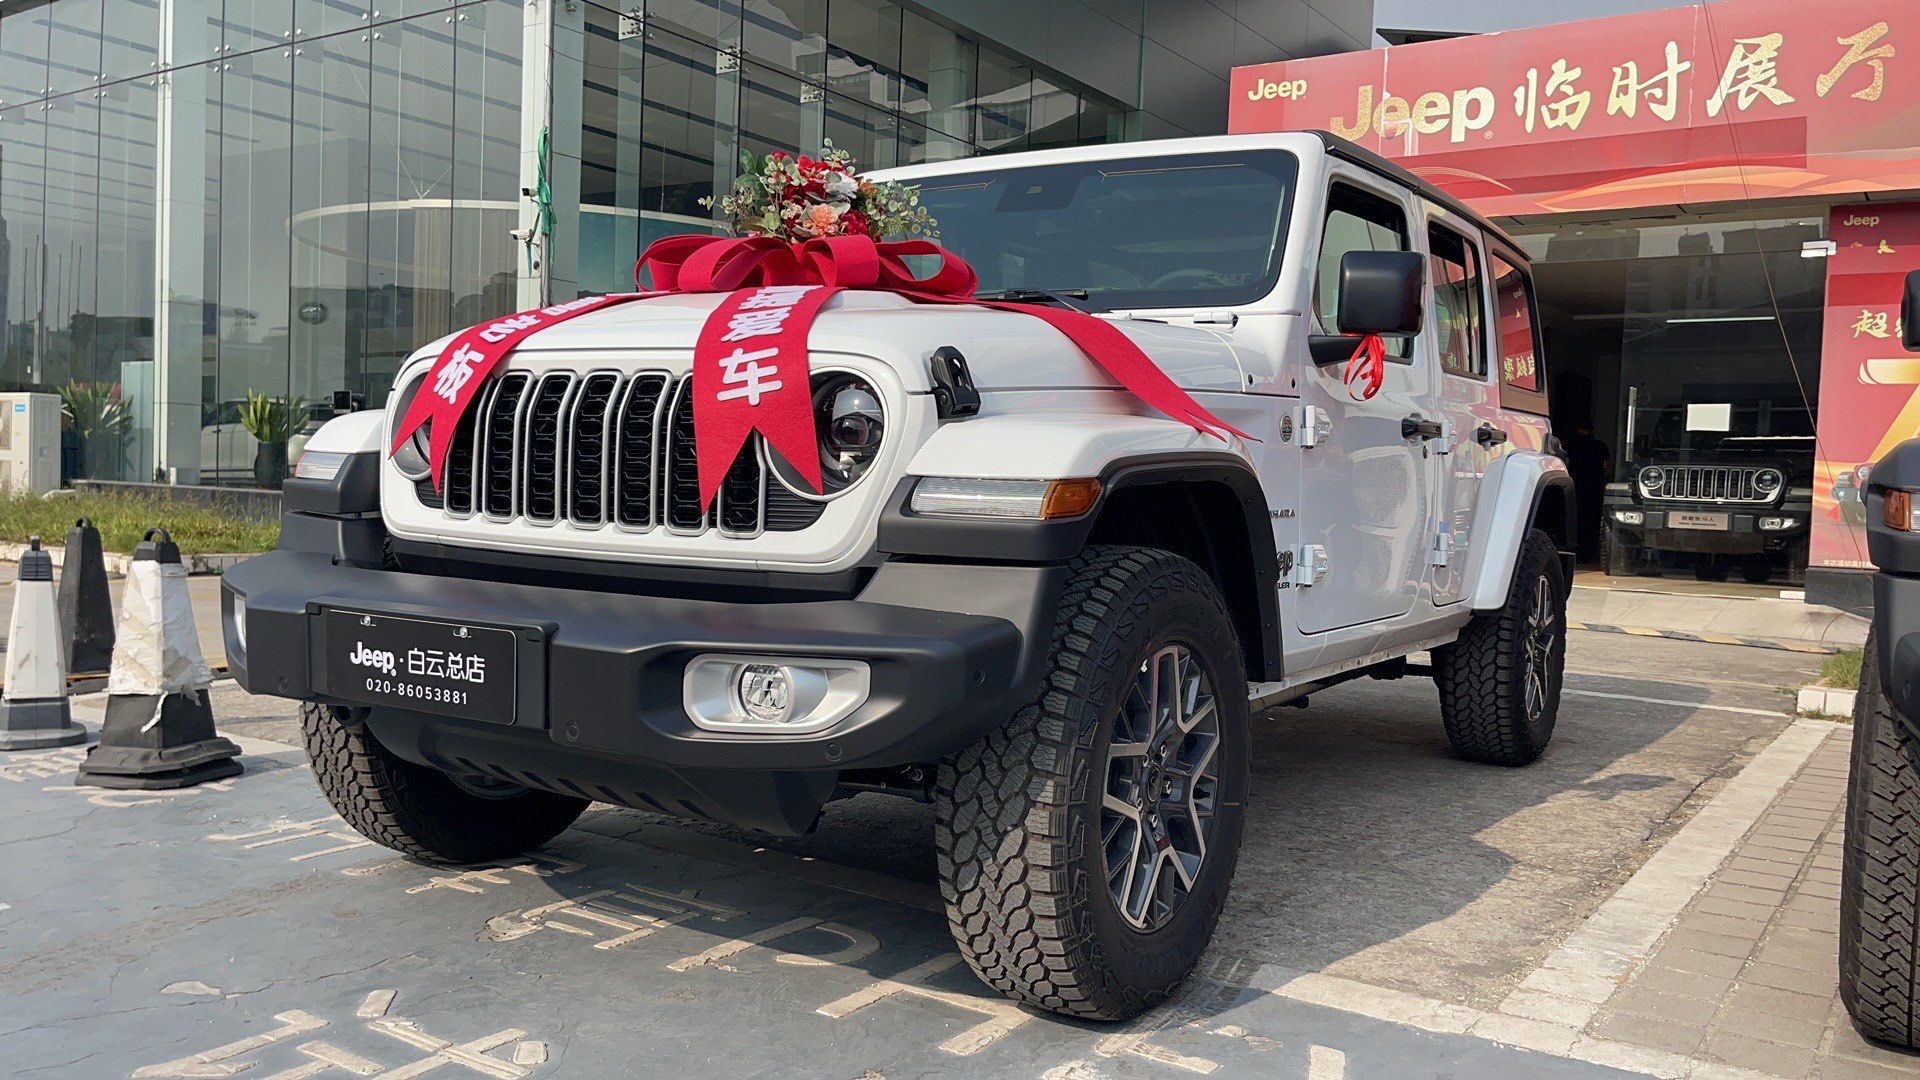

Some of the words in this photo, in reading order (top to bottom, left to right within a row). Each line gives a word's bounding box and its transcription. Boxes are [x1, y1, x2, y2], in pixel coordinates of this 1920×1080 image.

[1247, 78, 1308, 102] Jeep
[1329, 85, 1496, 144] Jeep
[1512, 22, 1897, 134] 临时展厅
[1843, 214, 1880, 227] Jeep
[1850, 309, 1904, 338] 超
[350, 641, 397, 677] Jeep
[366, 678, 468, 705] 020-86053881
